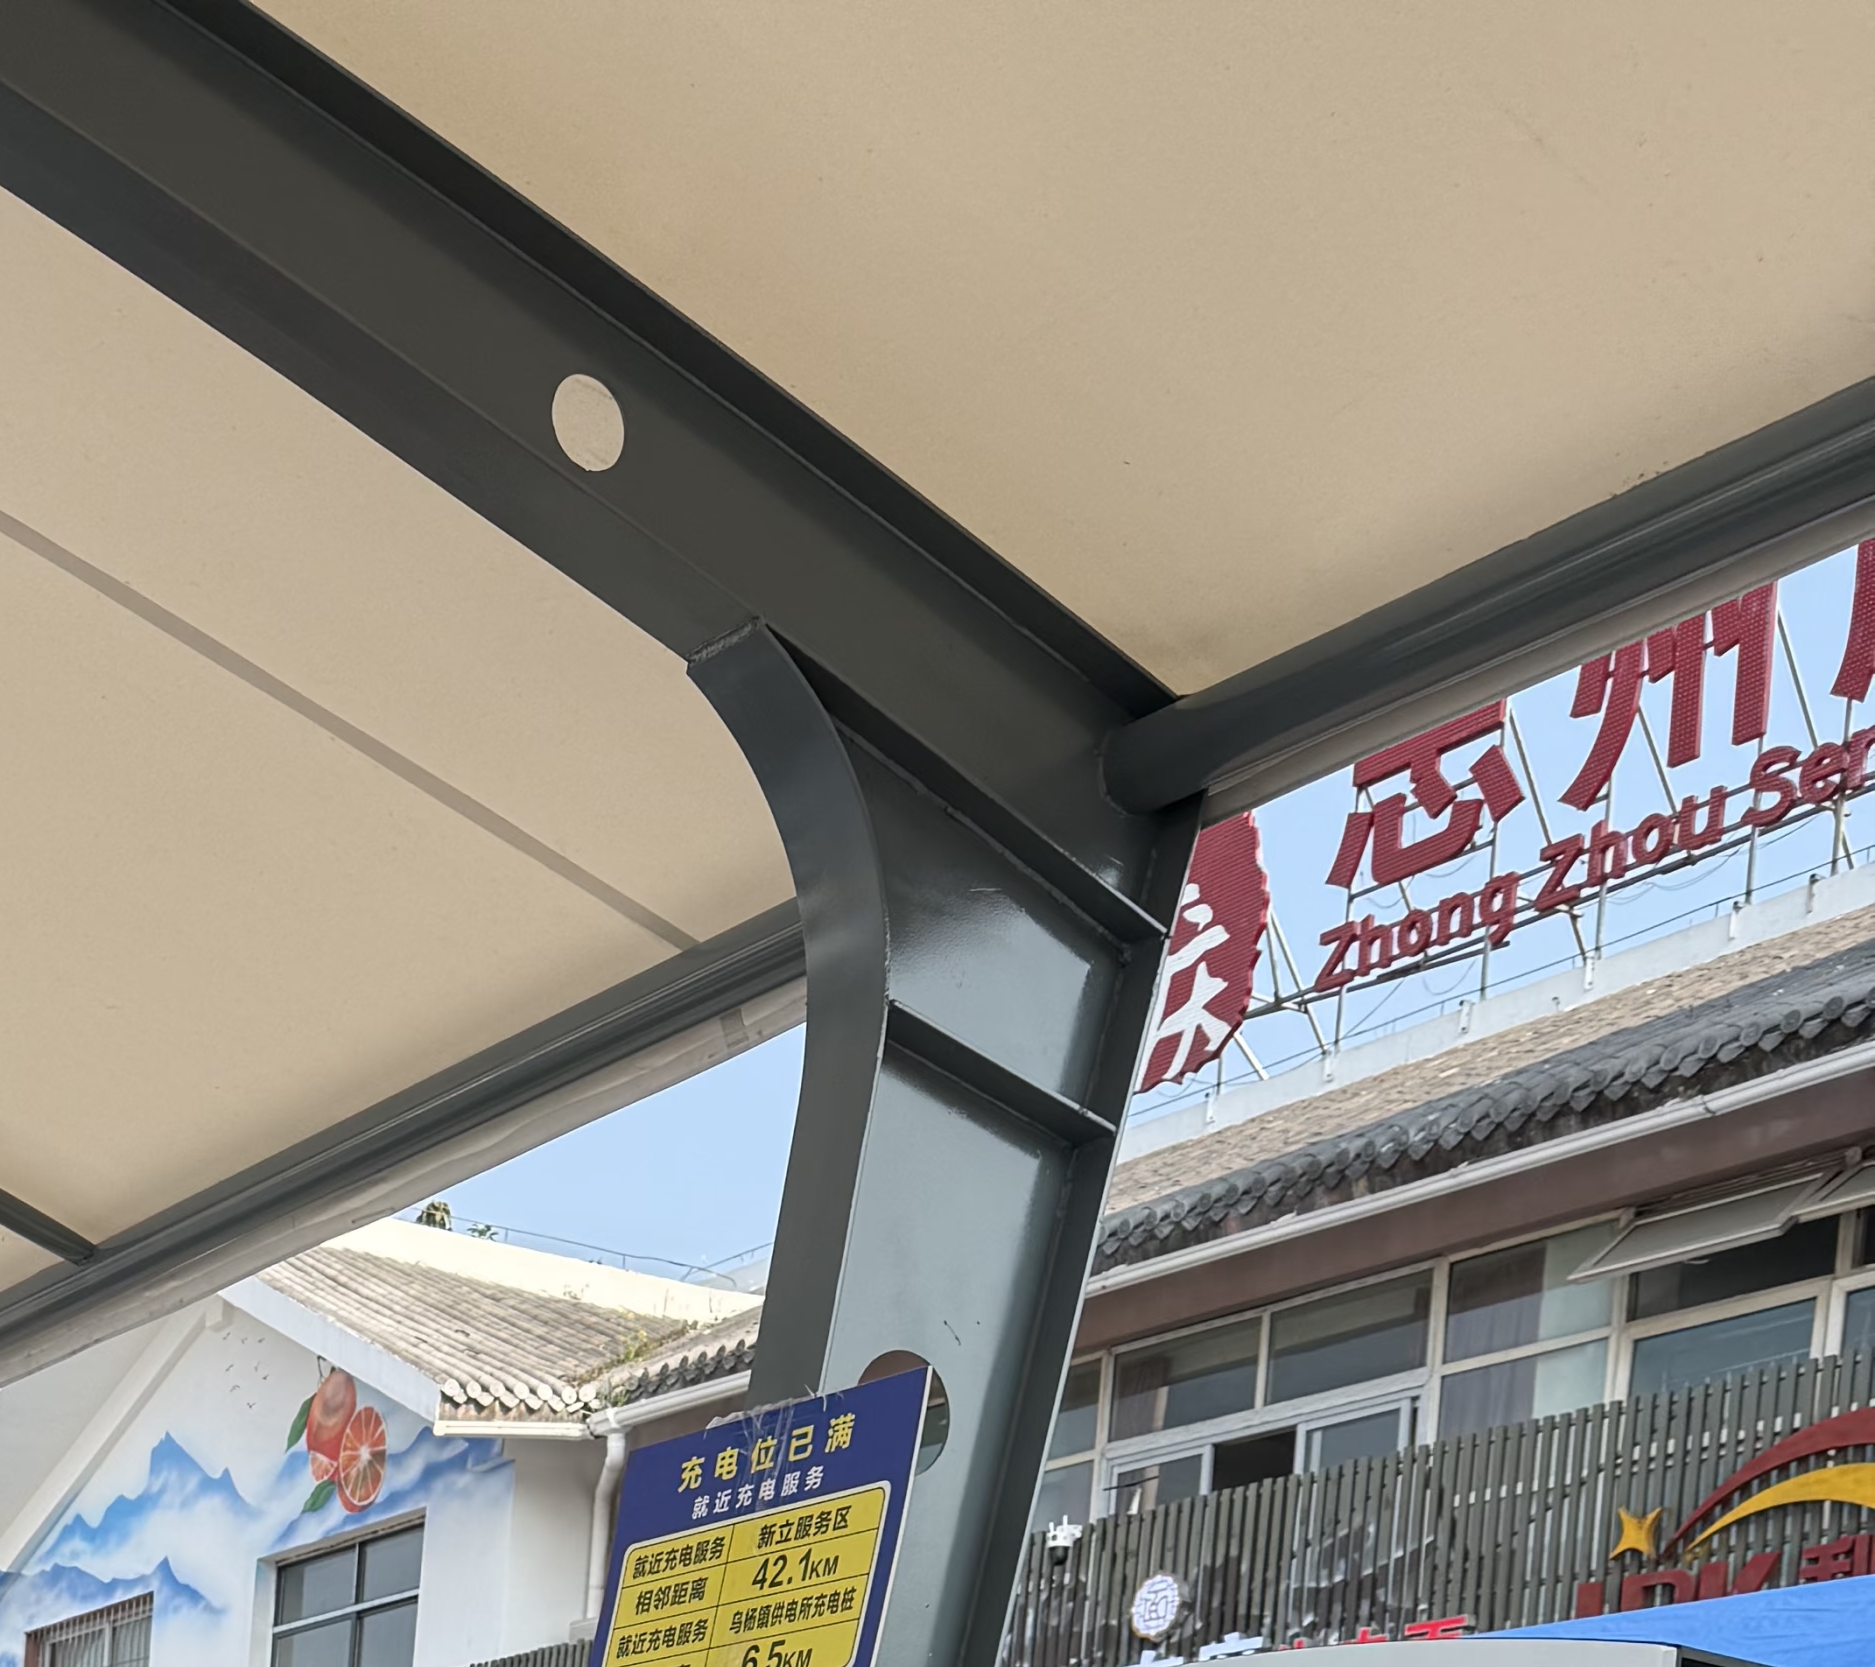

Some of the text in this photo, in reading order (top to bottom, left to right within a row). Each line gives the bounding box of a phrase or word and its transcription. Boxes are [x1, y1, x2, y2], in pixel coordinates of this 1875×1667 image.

[1326, 537, 1875, 888] 忠州
[1314, 871, 1520, 993] Zhong
[1533, 785, 1728, 913] Zhou
[678, 1412, 855, 1493] 充电位已满
[692, 1465, 824, 1520] 就近充电服务
[757, 1505, 852, 1550] 新立服务区
[632, 1535, 725, 1580] 就近充电服务
[751, 1548, 839, 1591] 42.1KM
[635, 1577, 708, 1615] 相邻距离
[729, 1586, 857, 1634] 乌杨镇供电所充电桩
[616, 1618, 709, 1659] 就近充电服务
